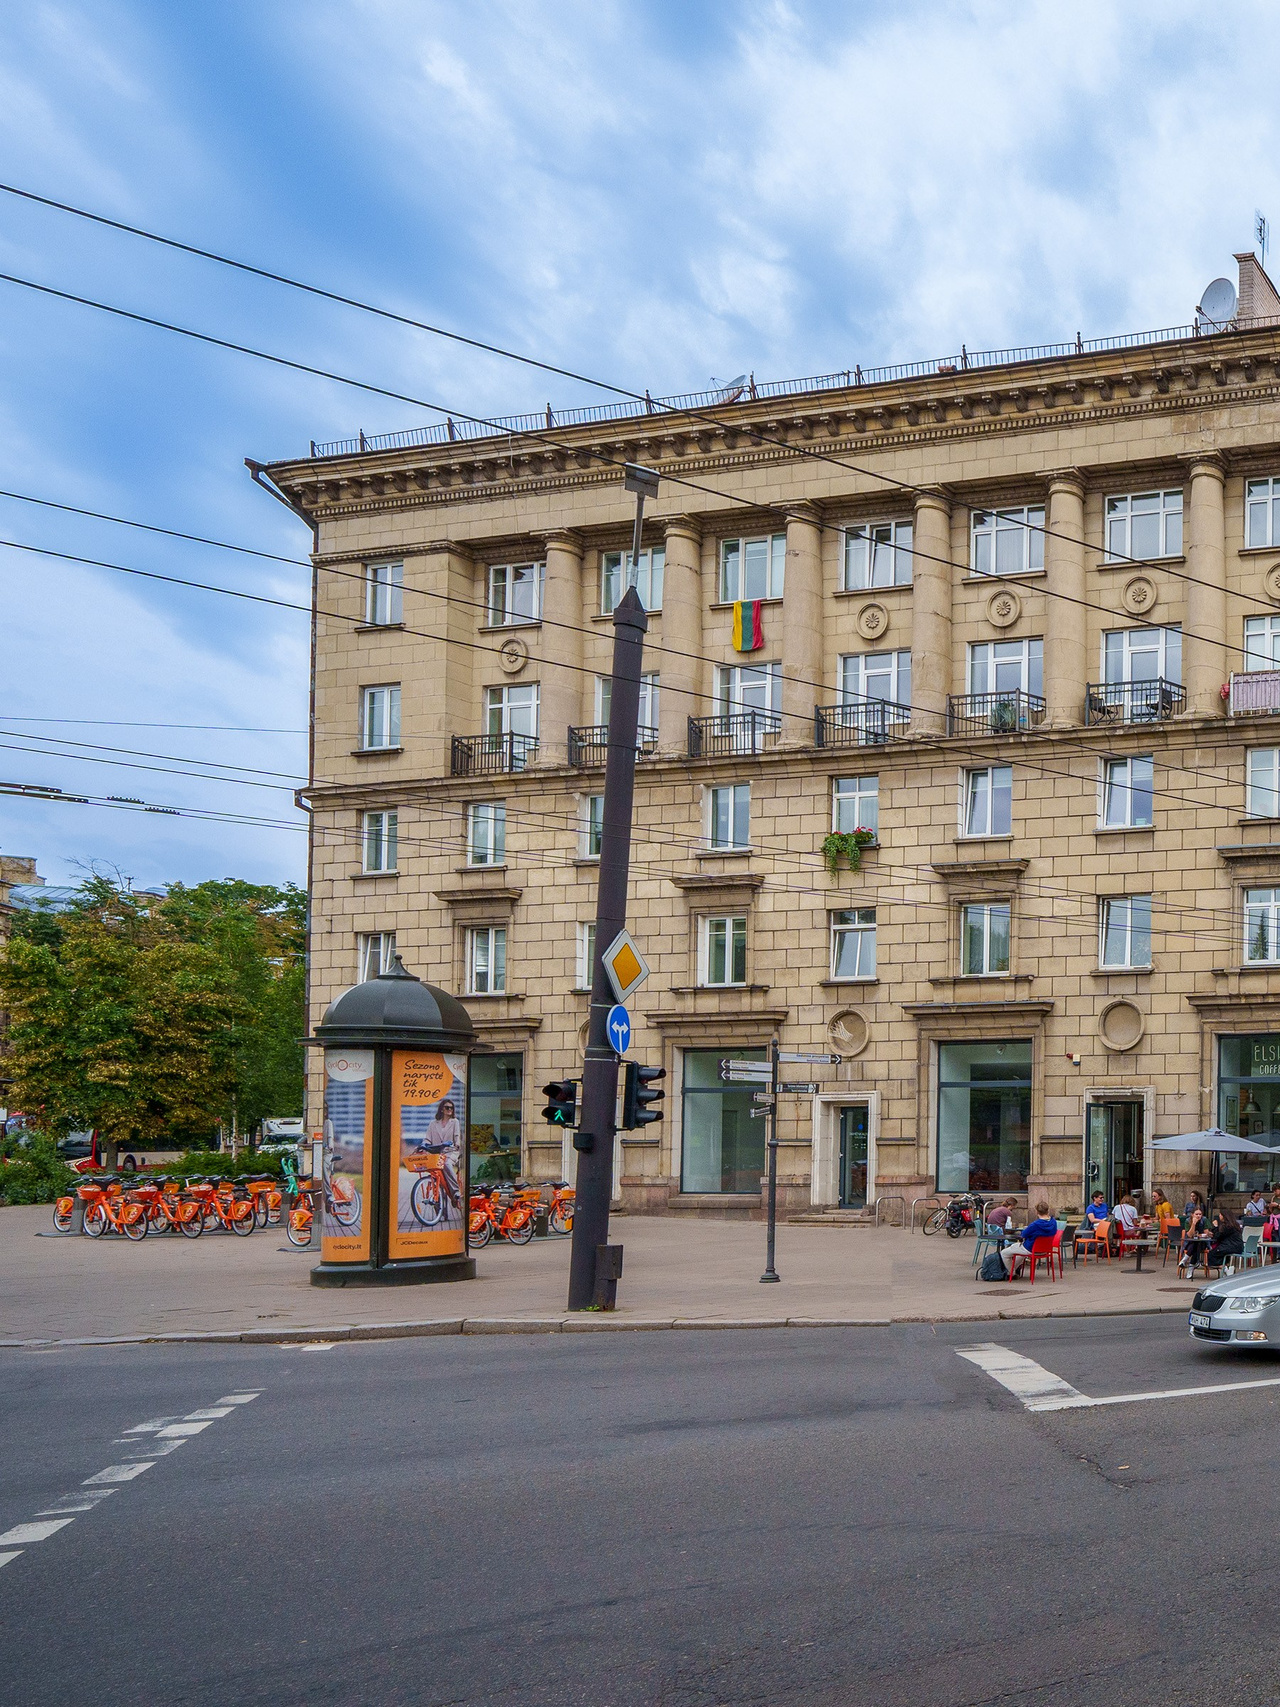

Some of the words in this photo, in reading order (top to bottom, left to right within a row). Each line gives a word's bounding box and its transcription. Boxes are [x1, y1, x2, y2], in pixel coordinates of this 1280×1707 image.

[404, 1059, 440, 1071] Sezono
[403, 1071, 444, 1083] narystė
[403, 1079, 418, 1088] tik
